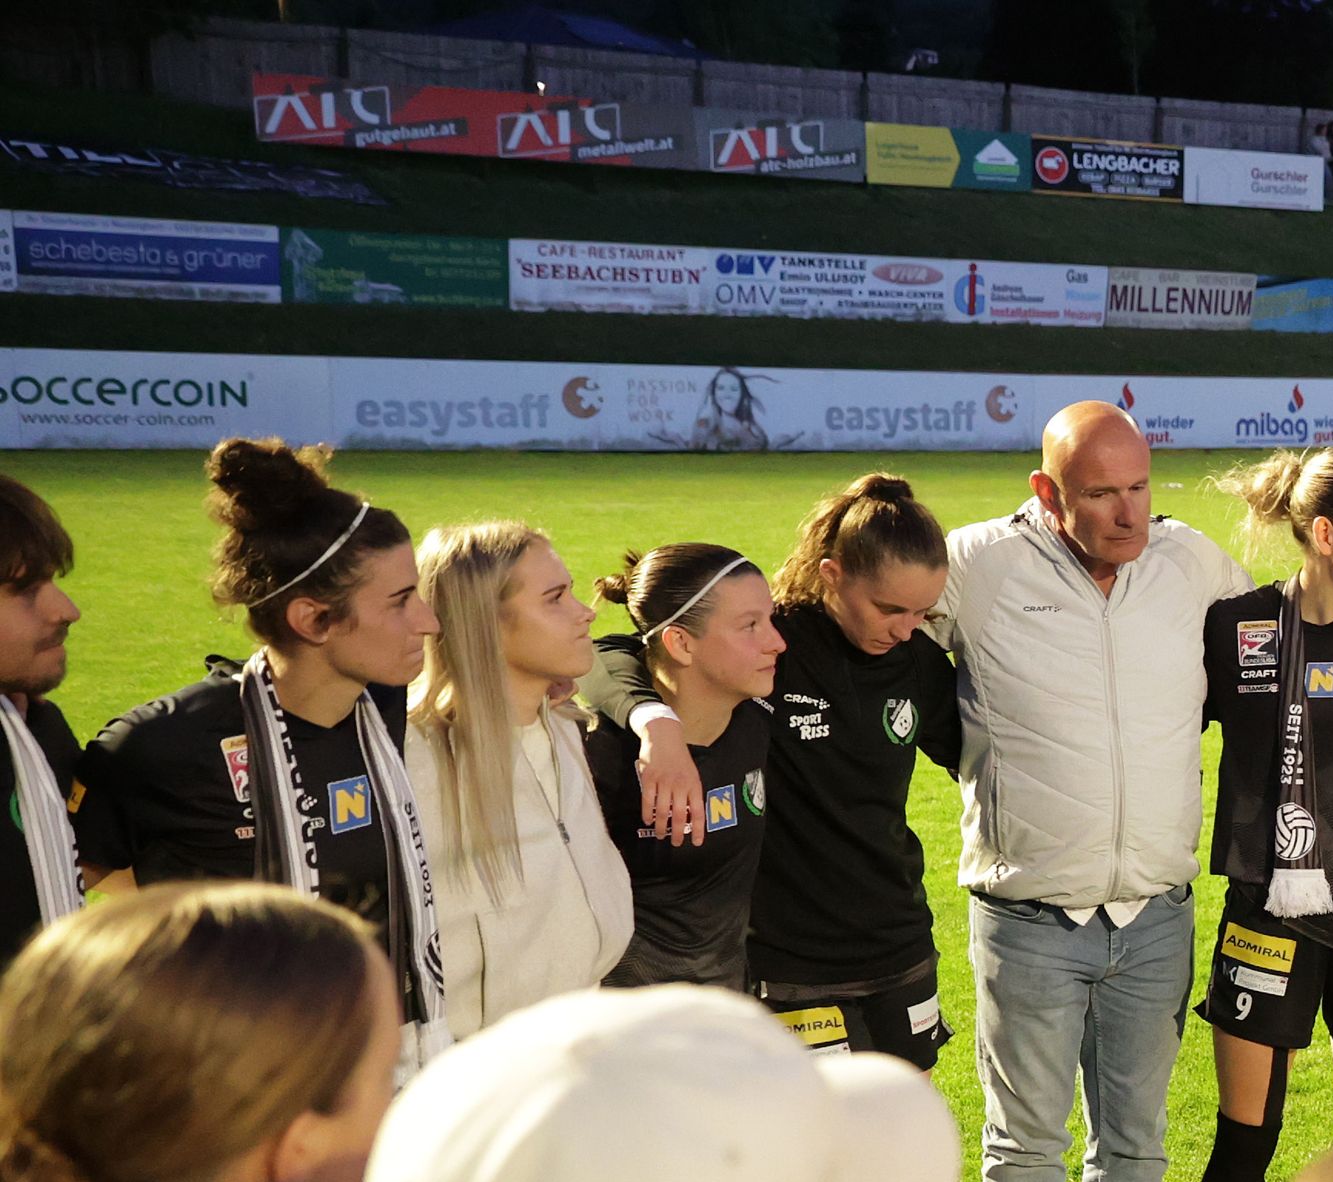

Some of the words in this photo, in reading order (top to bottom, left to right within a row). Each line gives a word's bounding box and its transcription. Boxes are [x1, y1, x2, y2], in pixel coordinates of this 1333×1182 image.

[356, 122, 457, 147] gutgebaut.at
[577, 136, 674, 160] metallwelt.at
[760, 153, 856, 173] atc-holzbau.at
[1073, 152, 1180, 176] LENGBACHER
[29, 238, 161, 265] schebesta
[183, 248, 266, 272] grüner
[780, 256, 867, 271] TANKSTELLE
[1066, 269, 1089, 284] Gas
[716, 283, 776, 305] OMV
[1109, 284, 1254, 316] MILLENNIUM
[21, 411, 215, 427] www.soccer-coin.com
[355, 393, 550, 436] easystaff
[825, 399, 976, 438] easystaff
[1146, 416, 1194, 429] wieder
[1236, 411, 1309, 443] mibag
[1241, 669, 1278, 679] CRAFT
[783, 693, 818, 708] CRAFT
[788, 712, 822, 728] SPORT
[1286, 704, 1303, 745] SEIT
[800, 724, 830, 741] RISS
[1280, 745, 1298, 786] 1923
[1226, 934, 1291, 962] ADMIRAL
[1234, 992, 1254, 1021] 9
